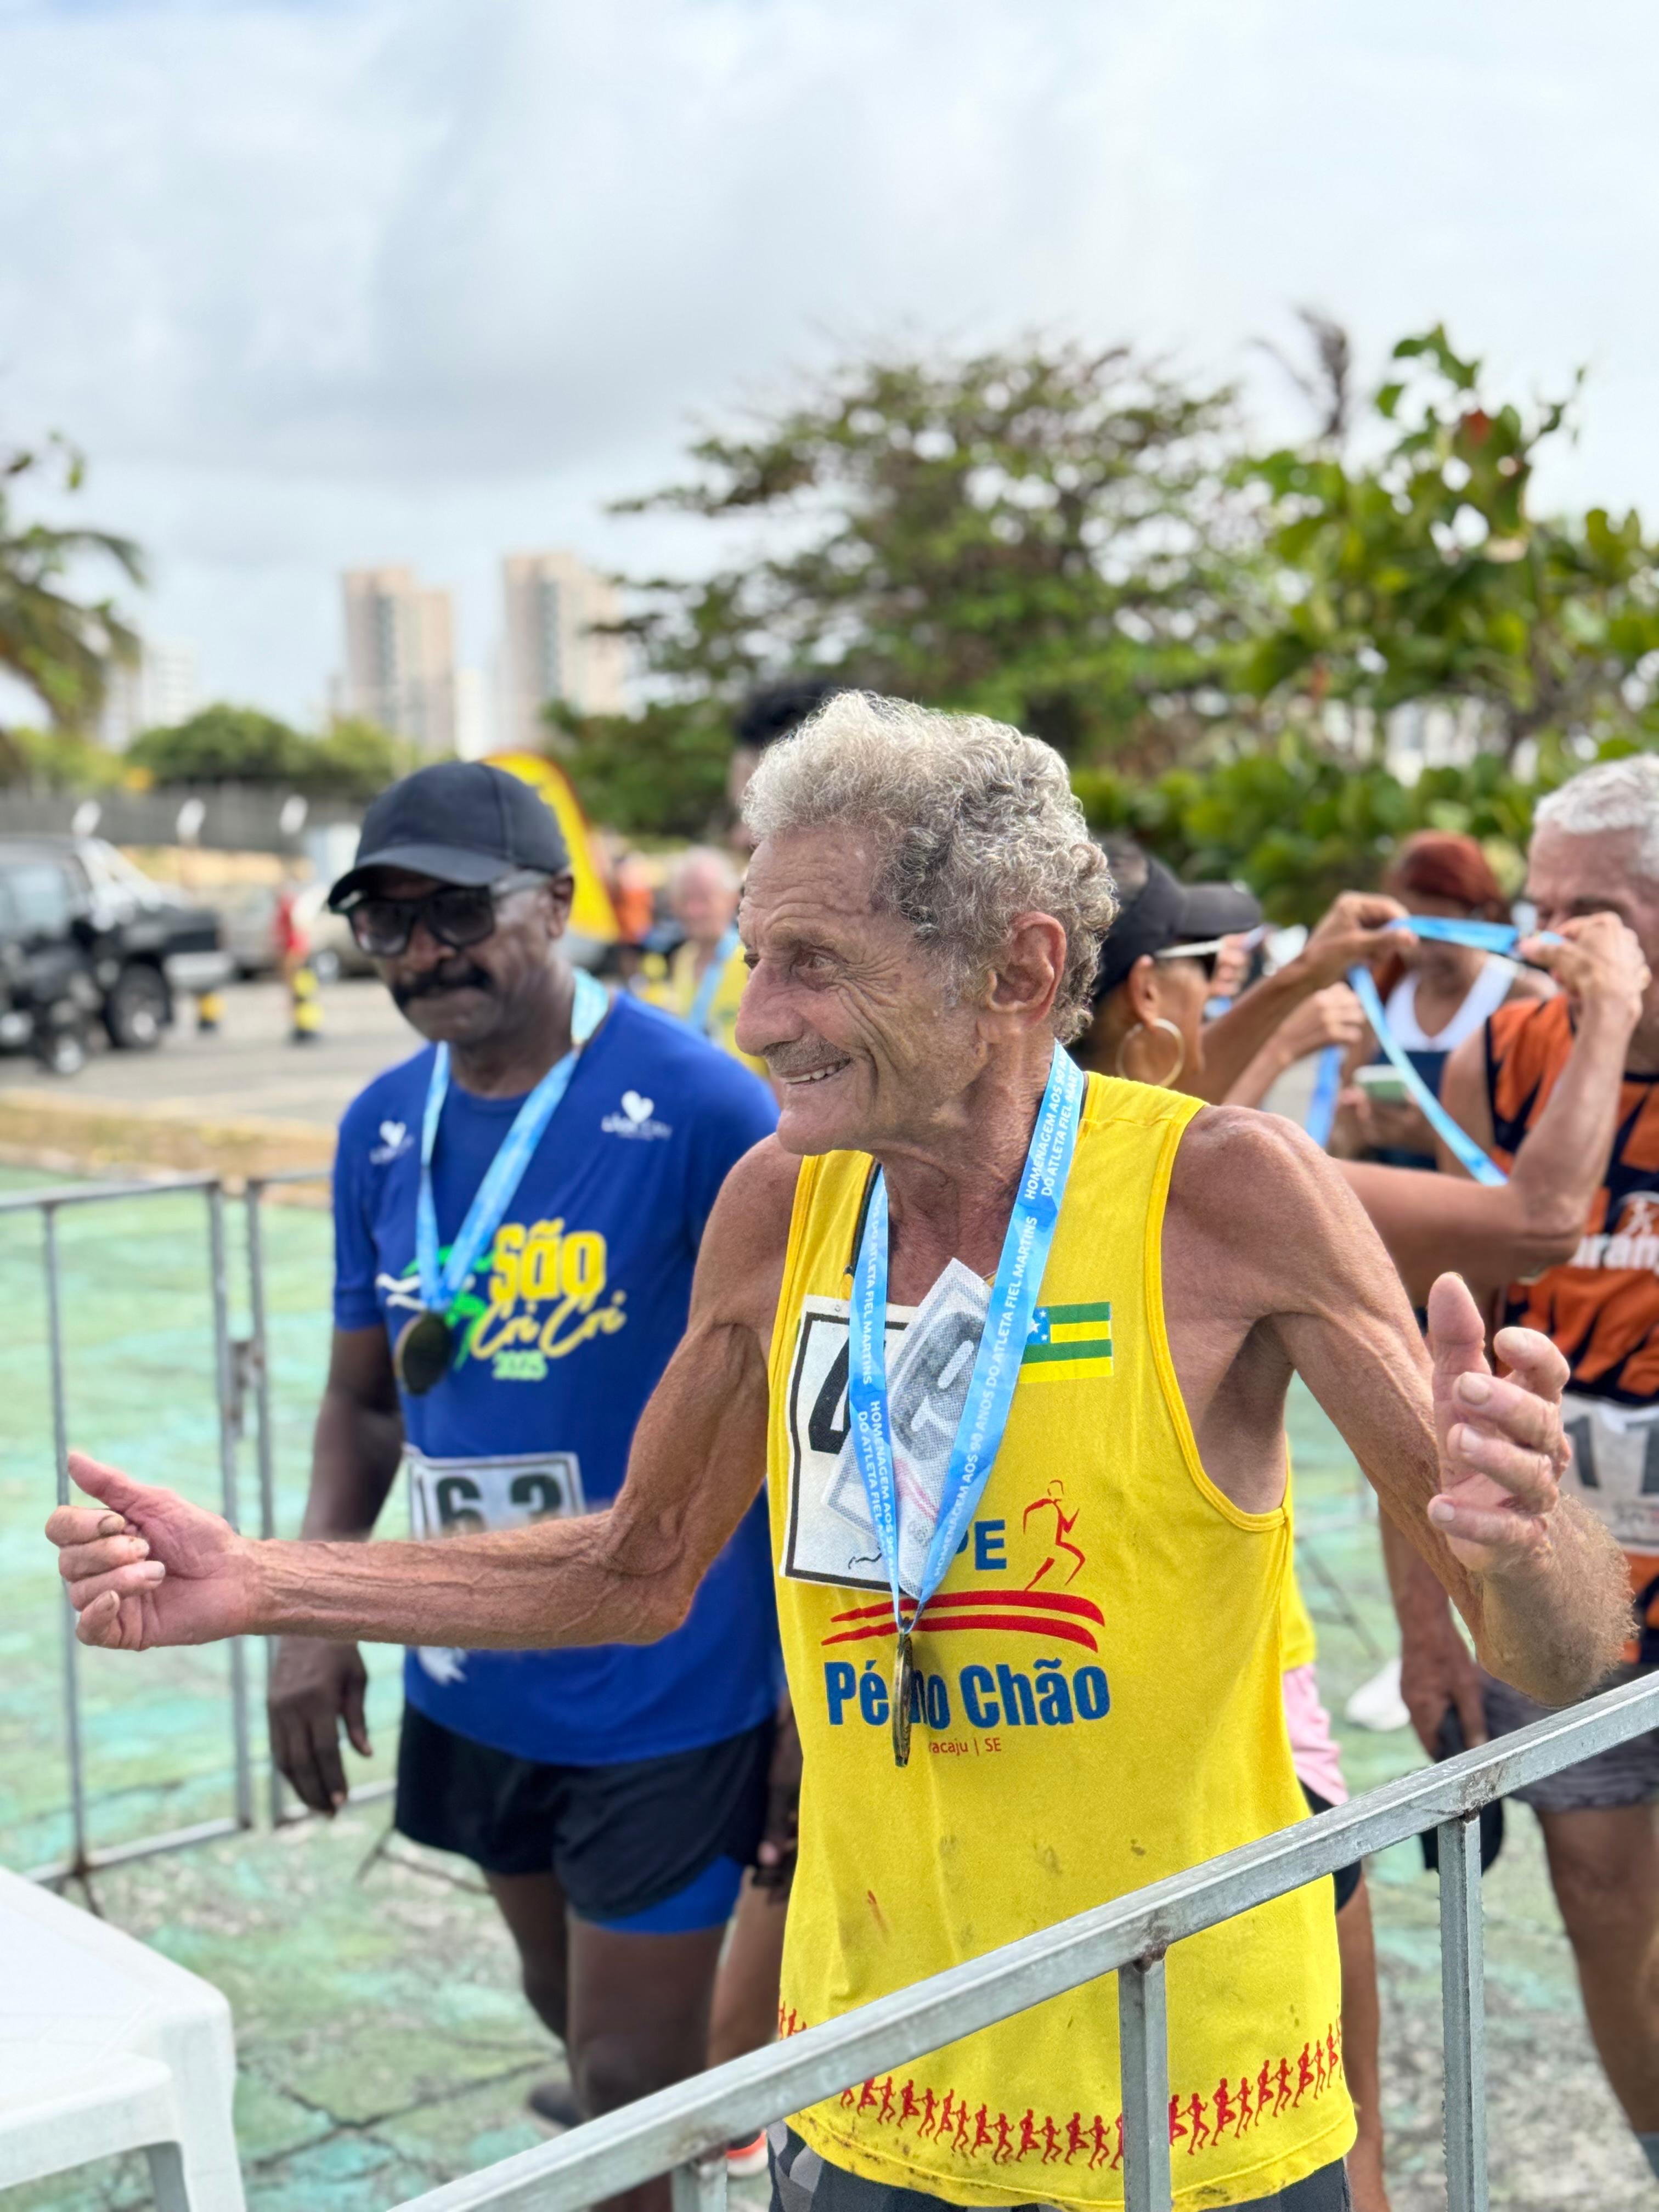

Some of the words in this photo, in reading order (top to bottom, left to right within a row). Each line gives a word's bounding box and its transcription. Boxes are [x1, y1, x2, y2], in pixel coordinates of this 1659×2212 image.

[1059, 1103, 1073, 1129] FIEL
[1024, 1113, 1056, 1200] HOMENAGEM
[1048, 1085, 1063, 1113] AOS
[1046, 1130, 1067, 1176] ATLETA
[1041, 1175, 1055, 1197] DO
[866, 1242, 878, 1289] ATLETA
[1012, 1216, 1037, 1278] MARTINS
[863, 1290, 875, 1319] FIEL
[1005, 1280, 1022, 1308] FIEL
[862, 1321, 873, 1385] MARTINS
[992, 1311, 1014, 1363] ATLETA
[985, 1365, 1001, 1387] DO
[857, 1410, 870, 1433] DO
[975, 1390, 995, 1431] ANOS
[861, 1436, 878, 1489] ATLETA
[970, 1432, 984, 1452] 90
[870, 1400, 890, 1500] HOMENAGEM
[883, 1502, 894, 1533] AOS
[962, 1454, 979, 1483] AOS
[871, 1492, 882, 1521] FIEL
[934, 1486, 970, 1577] HOMENAGEM
[824, 1660, 889, 1726] Pé
[909, 1669, 950, 1730] no
[959, 1657, 1110, 1729] Chão
[985, 1737, 1002, 1752] SE
